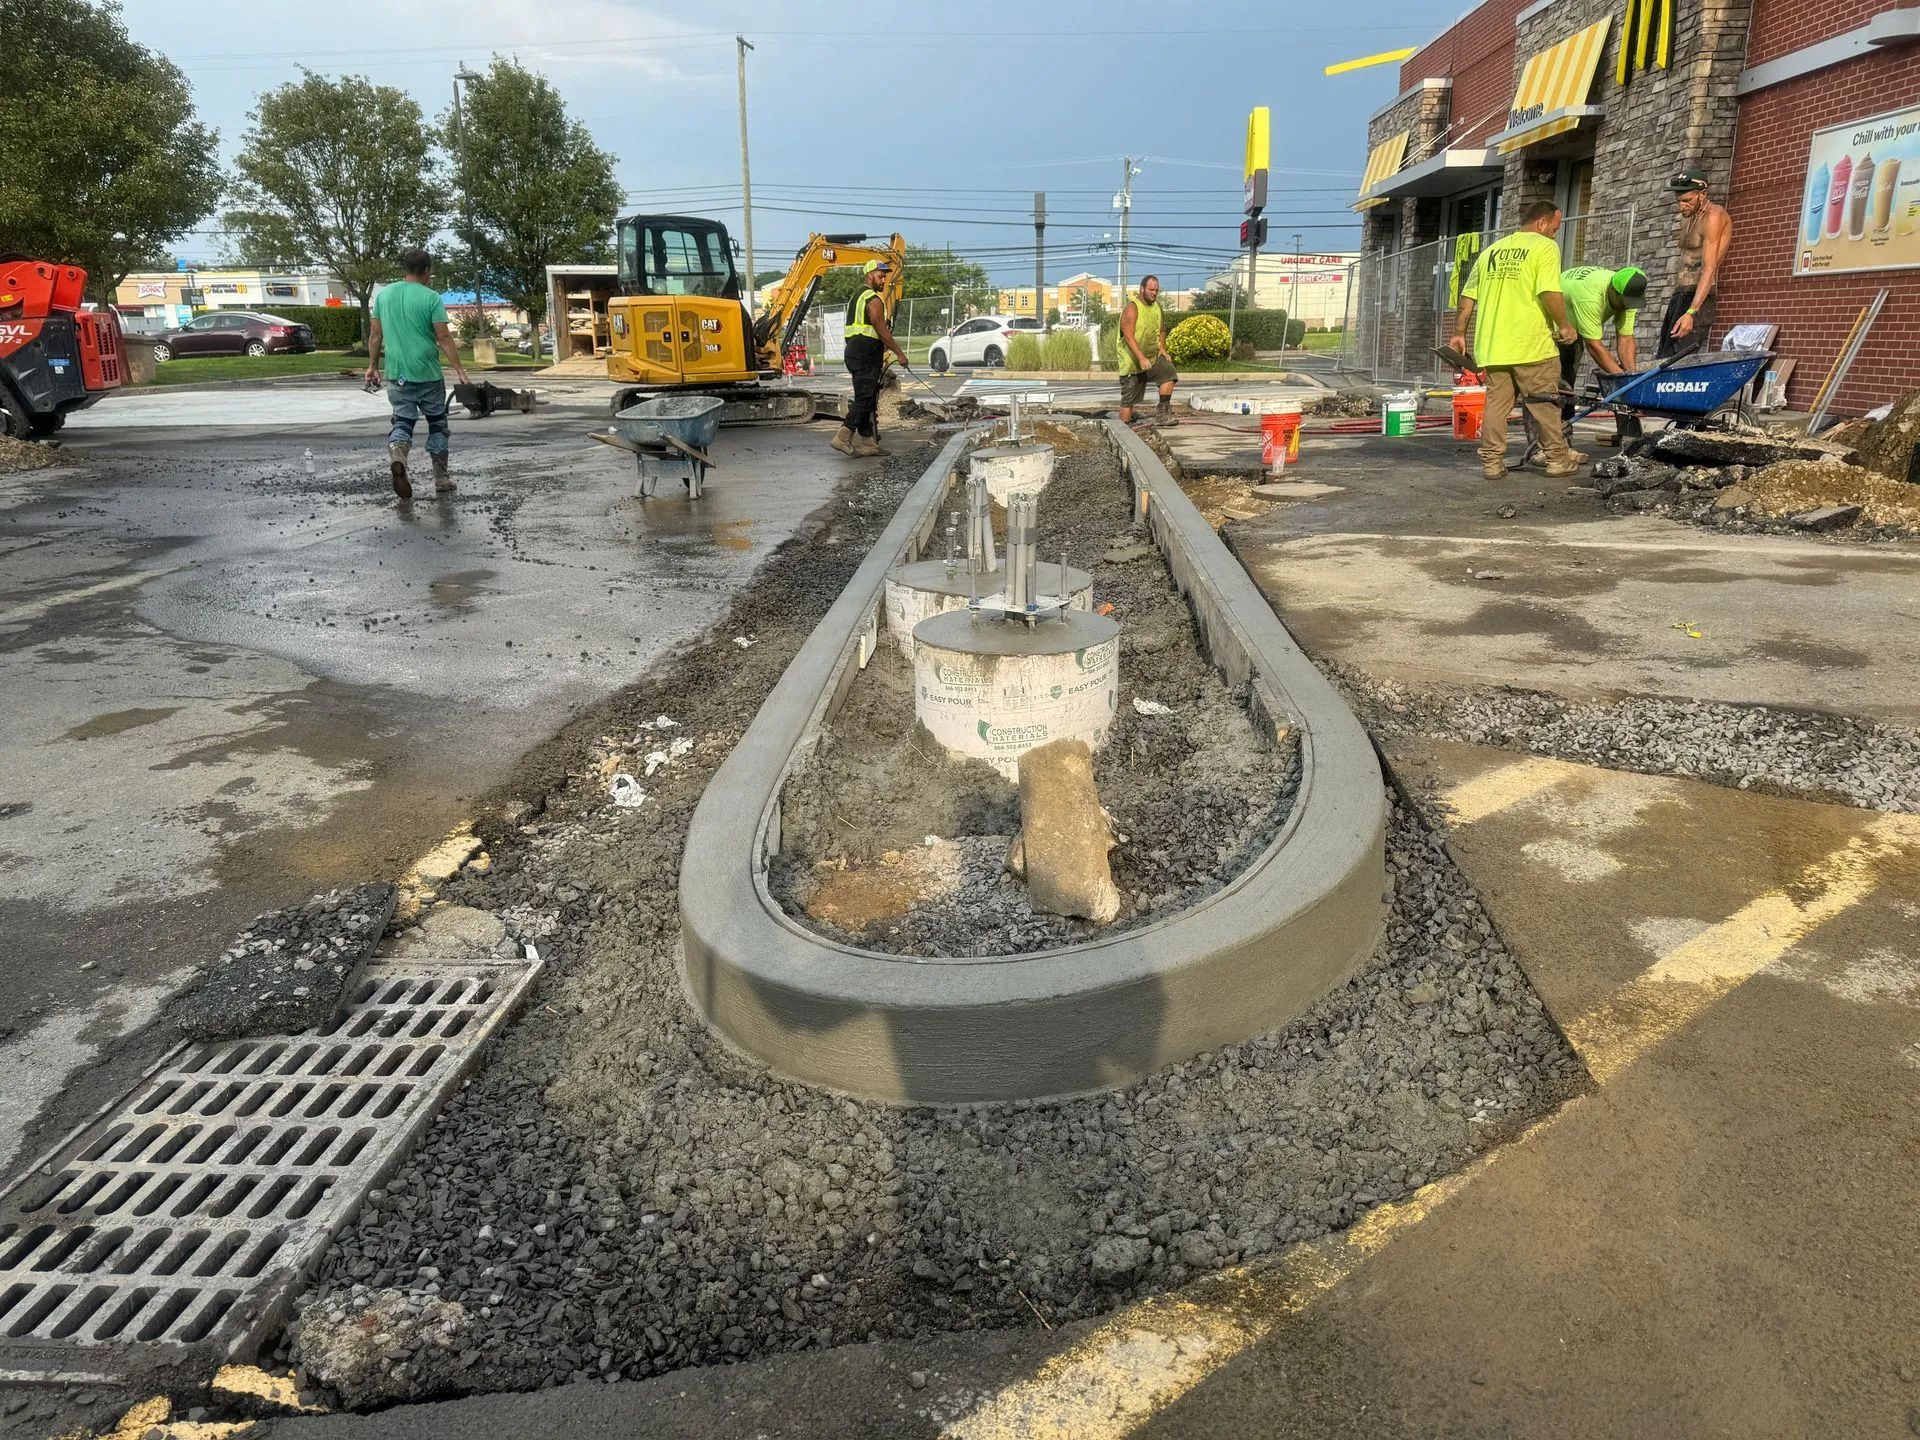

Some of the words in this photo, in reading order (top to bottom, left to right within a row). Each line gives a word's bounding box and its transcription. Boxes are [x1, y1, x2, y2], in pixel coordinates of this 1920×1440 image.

[1509, 102, 1544, 129] Welcome
[1853, 129, 1874, 146] Chill
[1874, 125, 1895, 141] with
[1894, 122, 1917, 141] your
[822, 249, 834, 260] CAT
[1320, 256, 1342, 264] CARE
[0, 325, 32, 335] SVL
[701, 319, 718, 330] CAT
[705, 344, 718, 352] 304
[1656, 381, 1710, 393] KOBALT
[1069, 682, 1089, 694] EASY
[1090, 674, 1107, 687] POUR
[930, 694, 947, 703] EASY
[992, 724, 1048, 736] CONSTRUCTION
[993, 731, 1048, 741] MATERIALS
